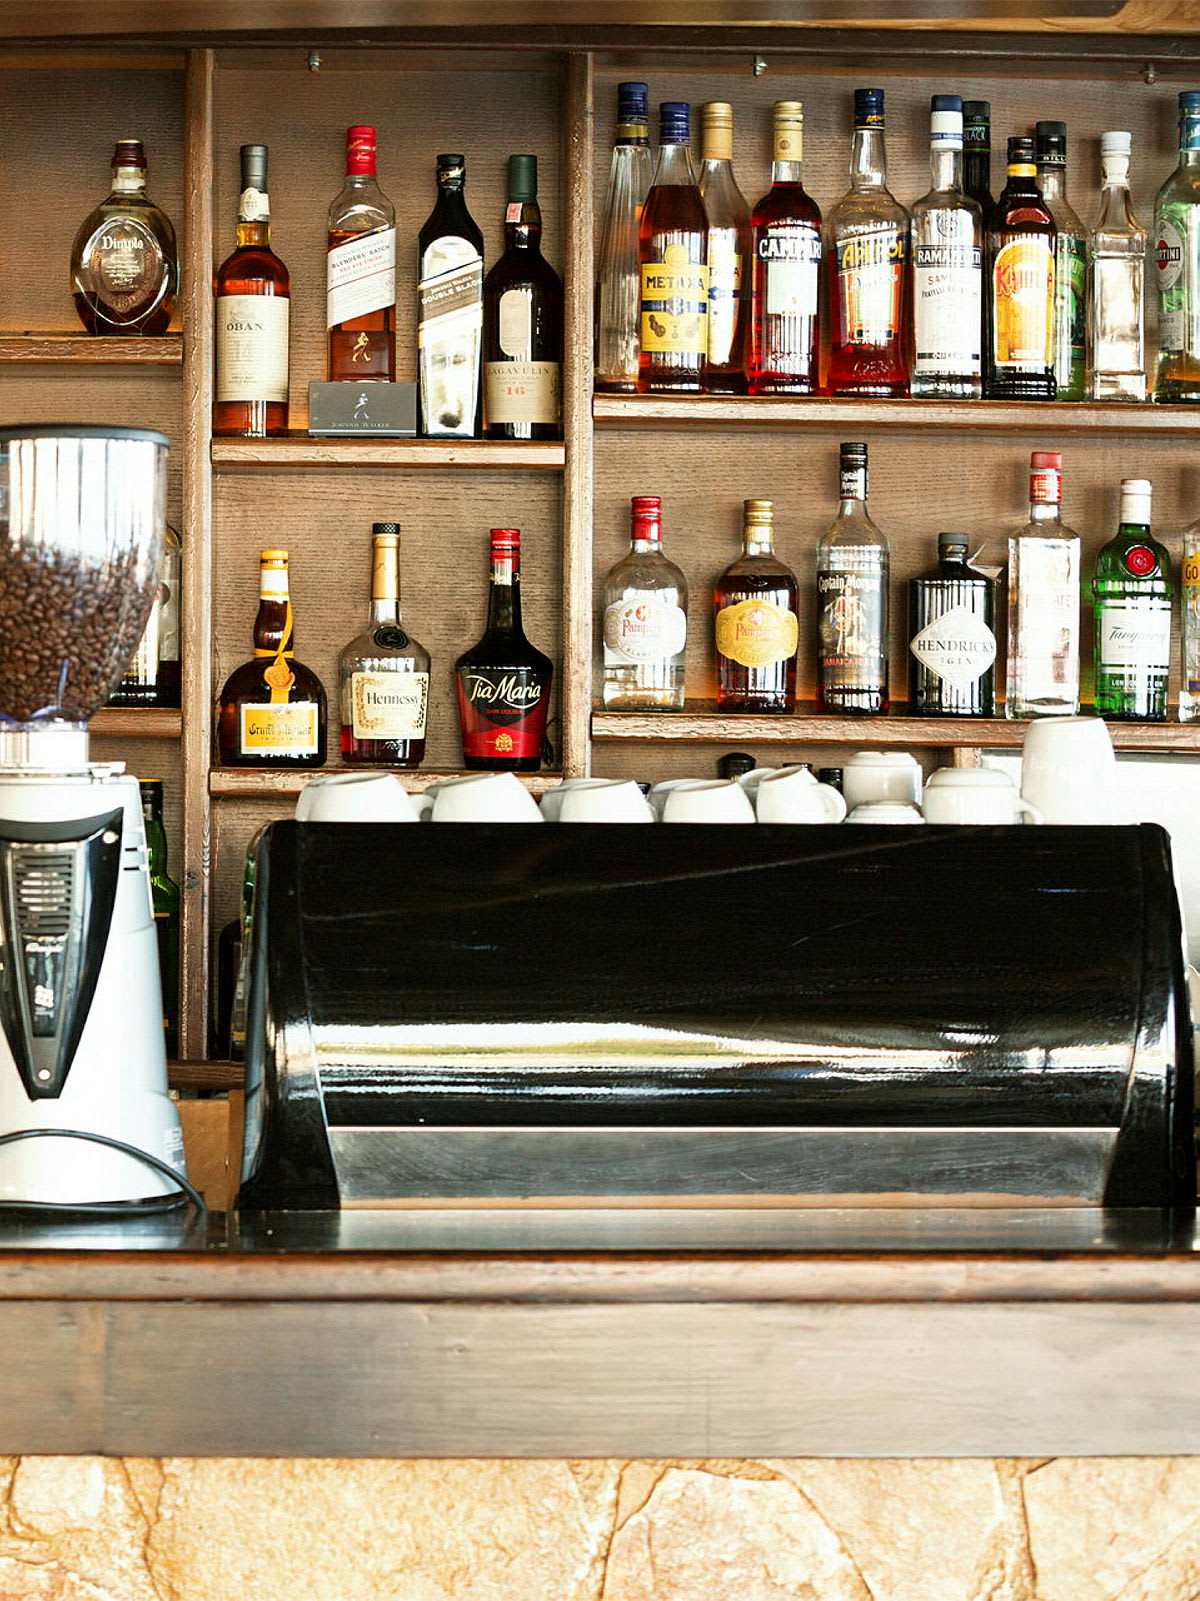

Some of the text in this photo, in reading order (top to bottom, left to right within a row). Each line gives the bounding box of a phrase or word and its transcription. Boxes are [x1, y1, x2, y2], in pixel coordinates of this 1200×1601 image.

[101, 235, 144, 252] Dimple
[759, 238, 822, 258] CAMPAR
[1157, 247, 1180, 261] RTINI
[646, 276, 705, 291] METAXA
[421, 288, 455, 305] DOUBLE
[226, 322, 264, 332] OBAN
[818, 575, 845, 594] Captain
[621, 618, 664, 638] Pamp
[464, 674, 541, 704] Tia Maria
[366, 691, 418, 708] Hennessy
